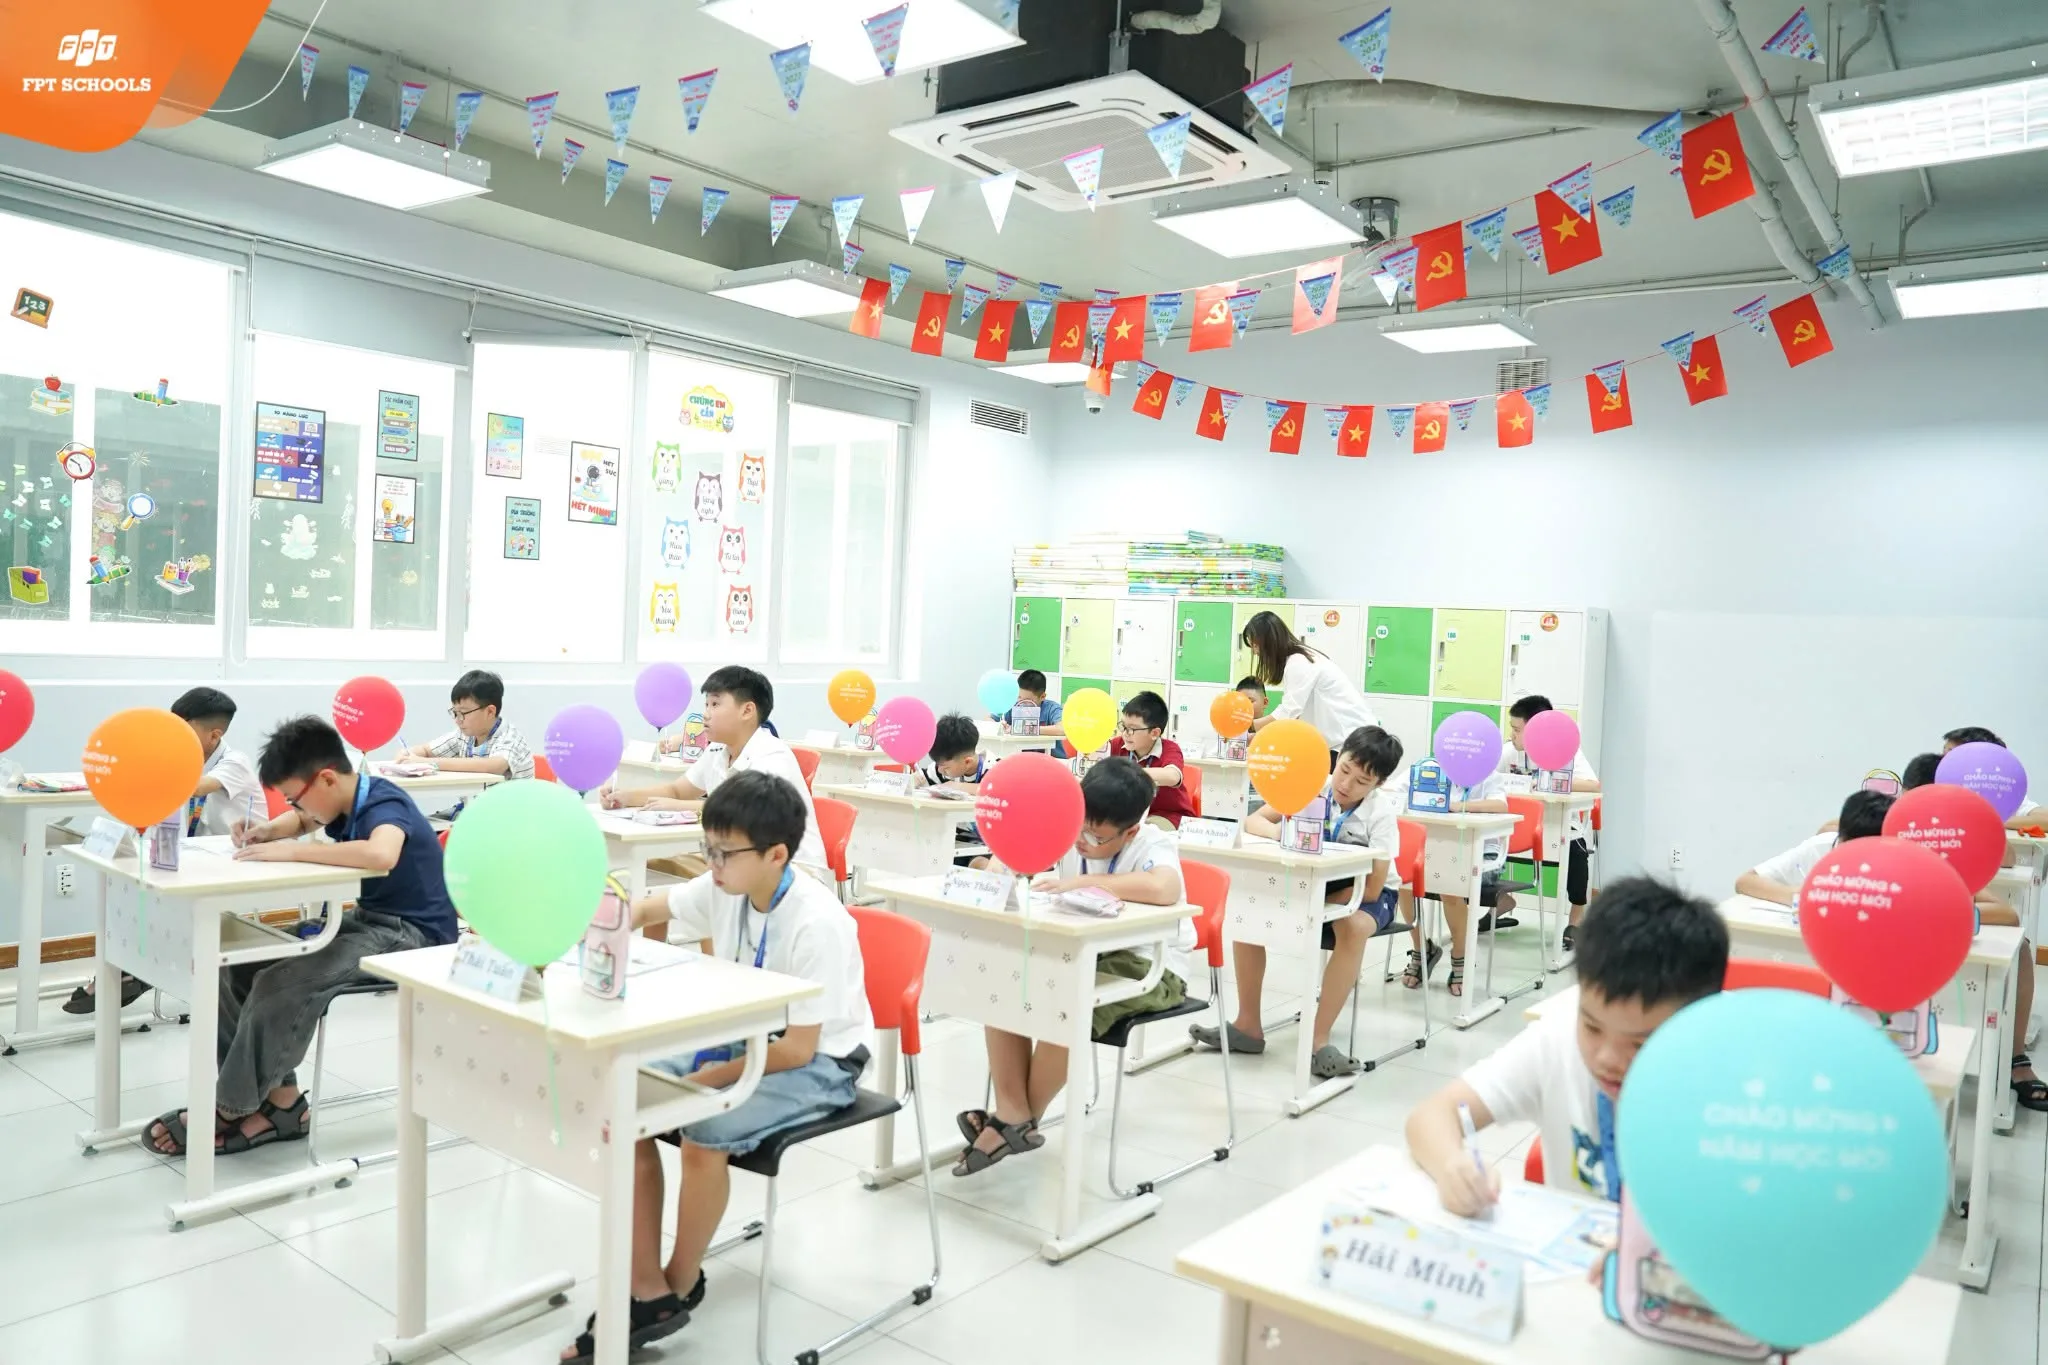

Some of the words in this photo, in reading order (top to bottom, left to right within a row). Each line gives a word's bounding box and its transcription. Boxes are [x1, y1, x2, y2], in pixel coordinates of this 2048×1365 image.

[716, 400, 726, 409] EM
[1964, 772, 1988, 782] CHÀO
[1898, 827, 1923, 839] CHÀO
[1924, 826, 1956, 838] MỪNG
[1940, 838, 1962, 850] MỚI
[953, 877, 972, 890] Ngọc
[1812, 874, 1844, 888] CHÀO
[1844, 877, 1888, 893] MỪNG
[1808, 887, 1831, 902] NĂM
[1832, 890, 1859, 906] HỌC
[1861, 892, 1892, 910] MỚI
[1704, 1101, 1783, 1133] CHÀO
[1792, 1105, 1877, 1136] MỪNG
[1699, 1137, 1764, 1163] NĂM
[1769, 1141, 1831, 1172] HỌC
[1838, 1142, 1892, 1170] MỚI
[1403, 1255, 1486, 1299] Minh
